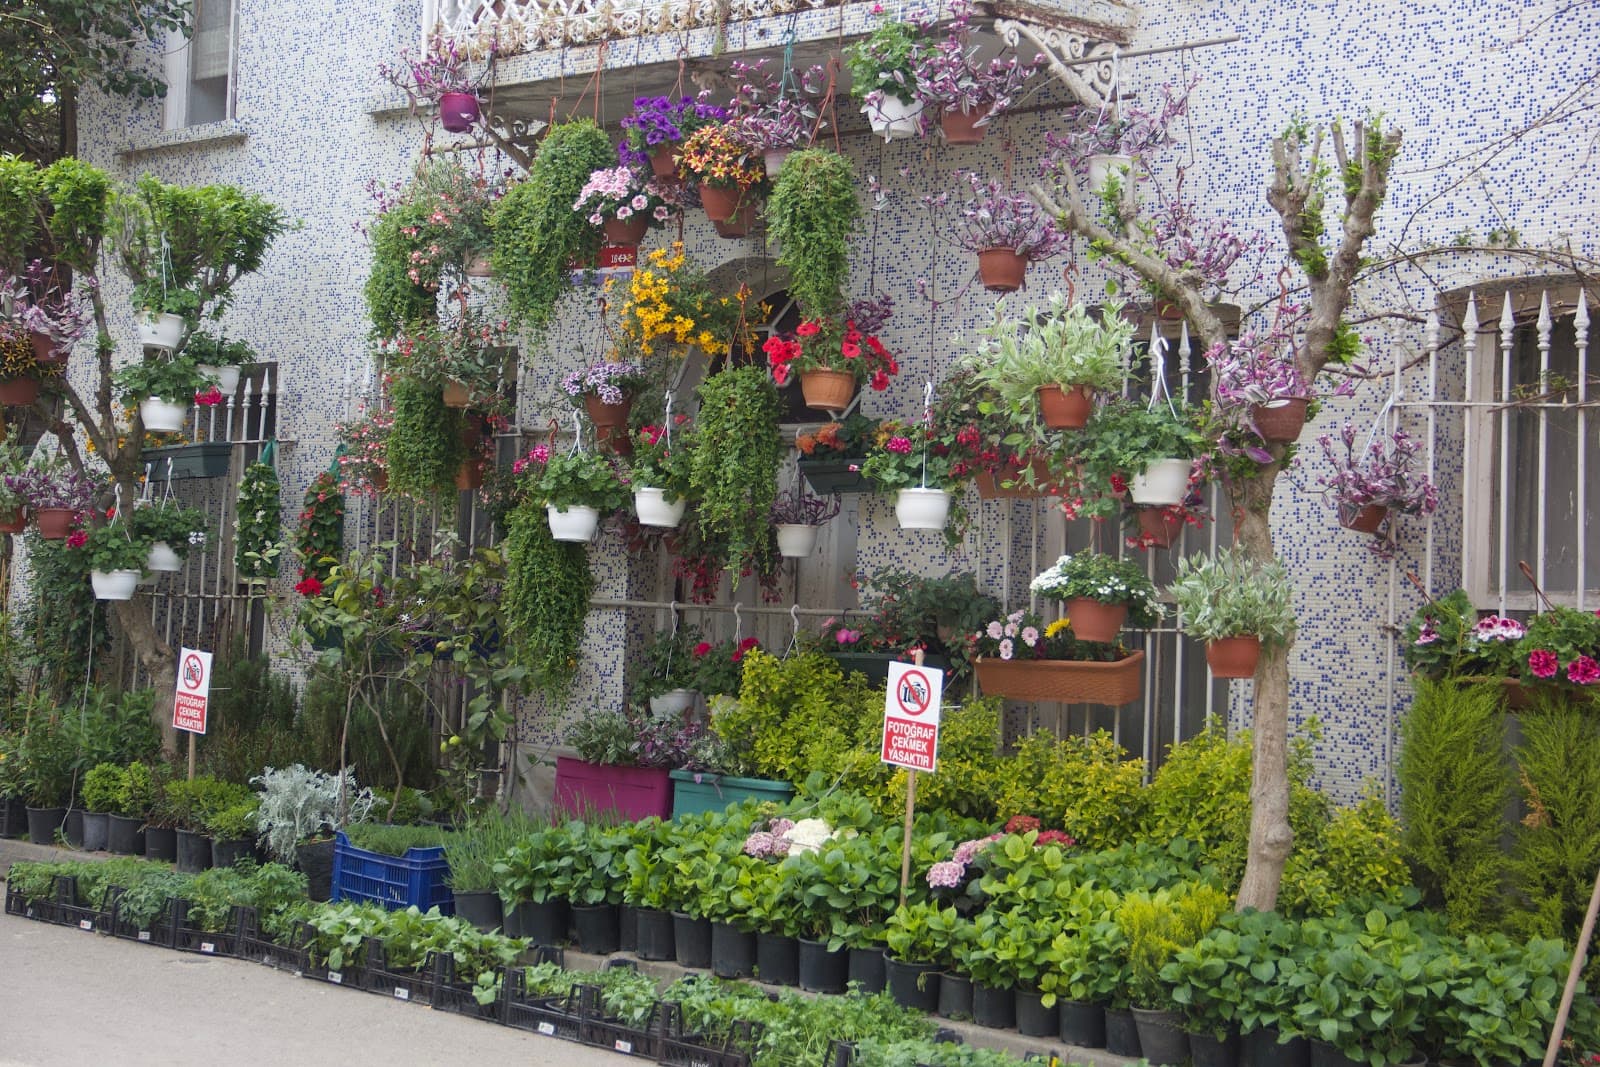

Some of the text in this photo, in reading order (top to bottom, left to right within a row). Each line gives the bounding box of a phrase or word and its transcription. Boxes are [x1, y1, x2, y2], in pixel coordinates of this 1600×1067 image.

[177, 695, 205, 709] FOTOĞRAF
[179, 706, 202, 720] ÇEKMEK
[176, 717, 203, 733] YASAKTIR
[887, 721, 935, 740] FOTOĞRAF
[891, 735, 929, 753] ÇEKMEK
[888, 748, 930, 767] YASAKTIR
